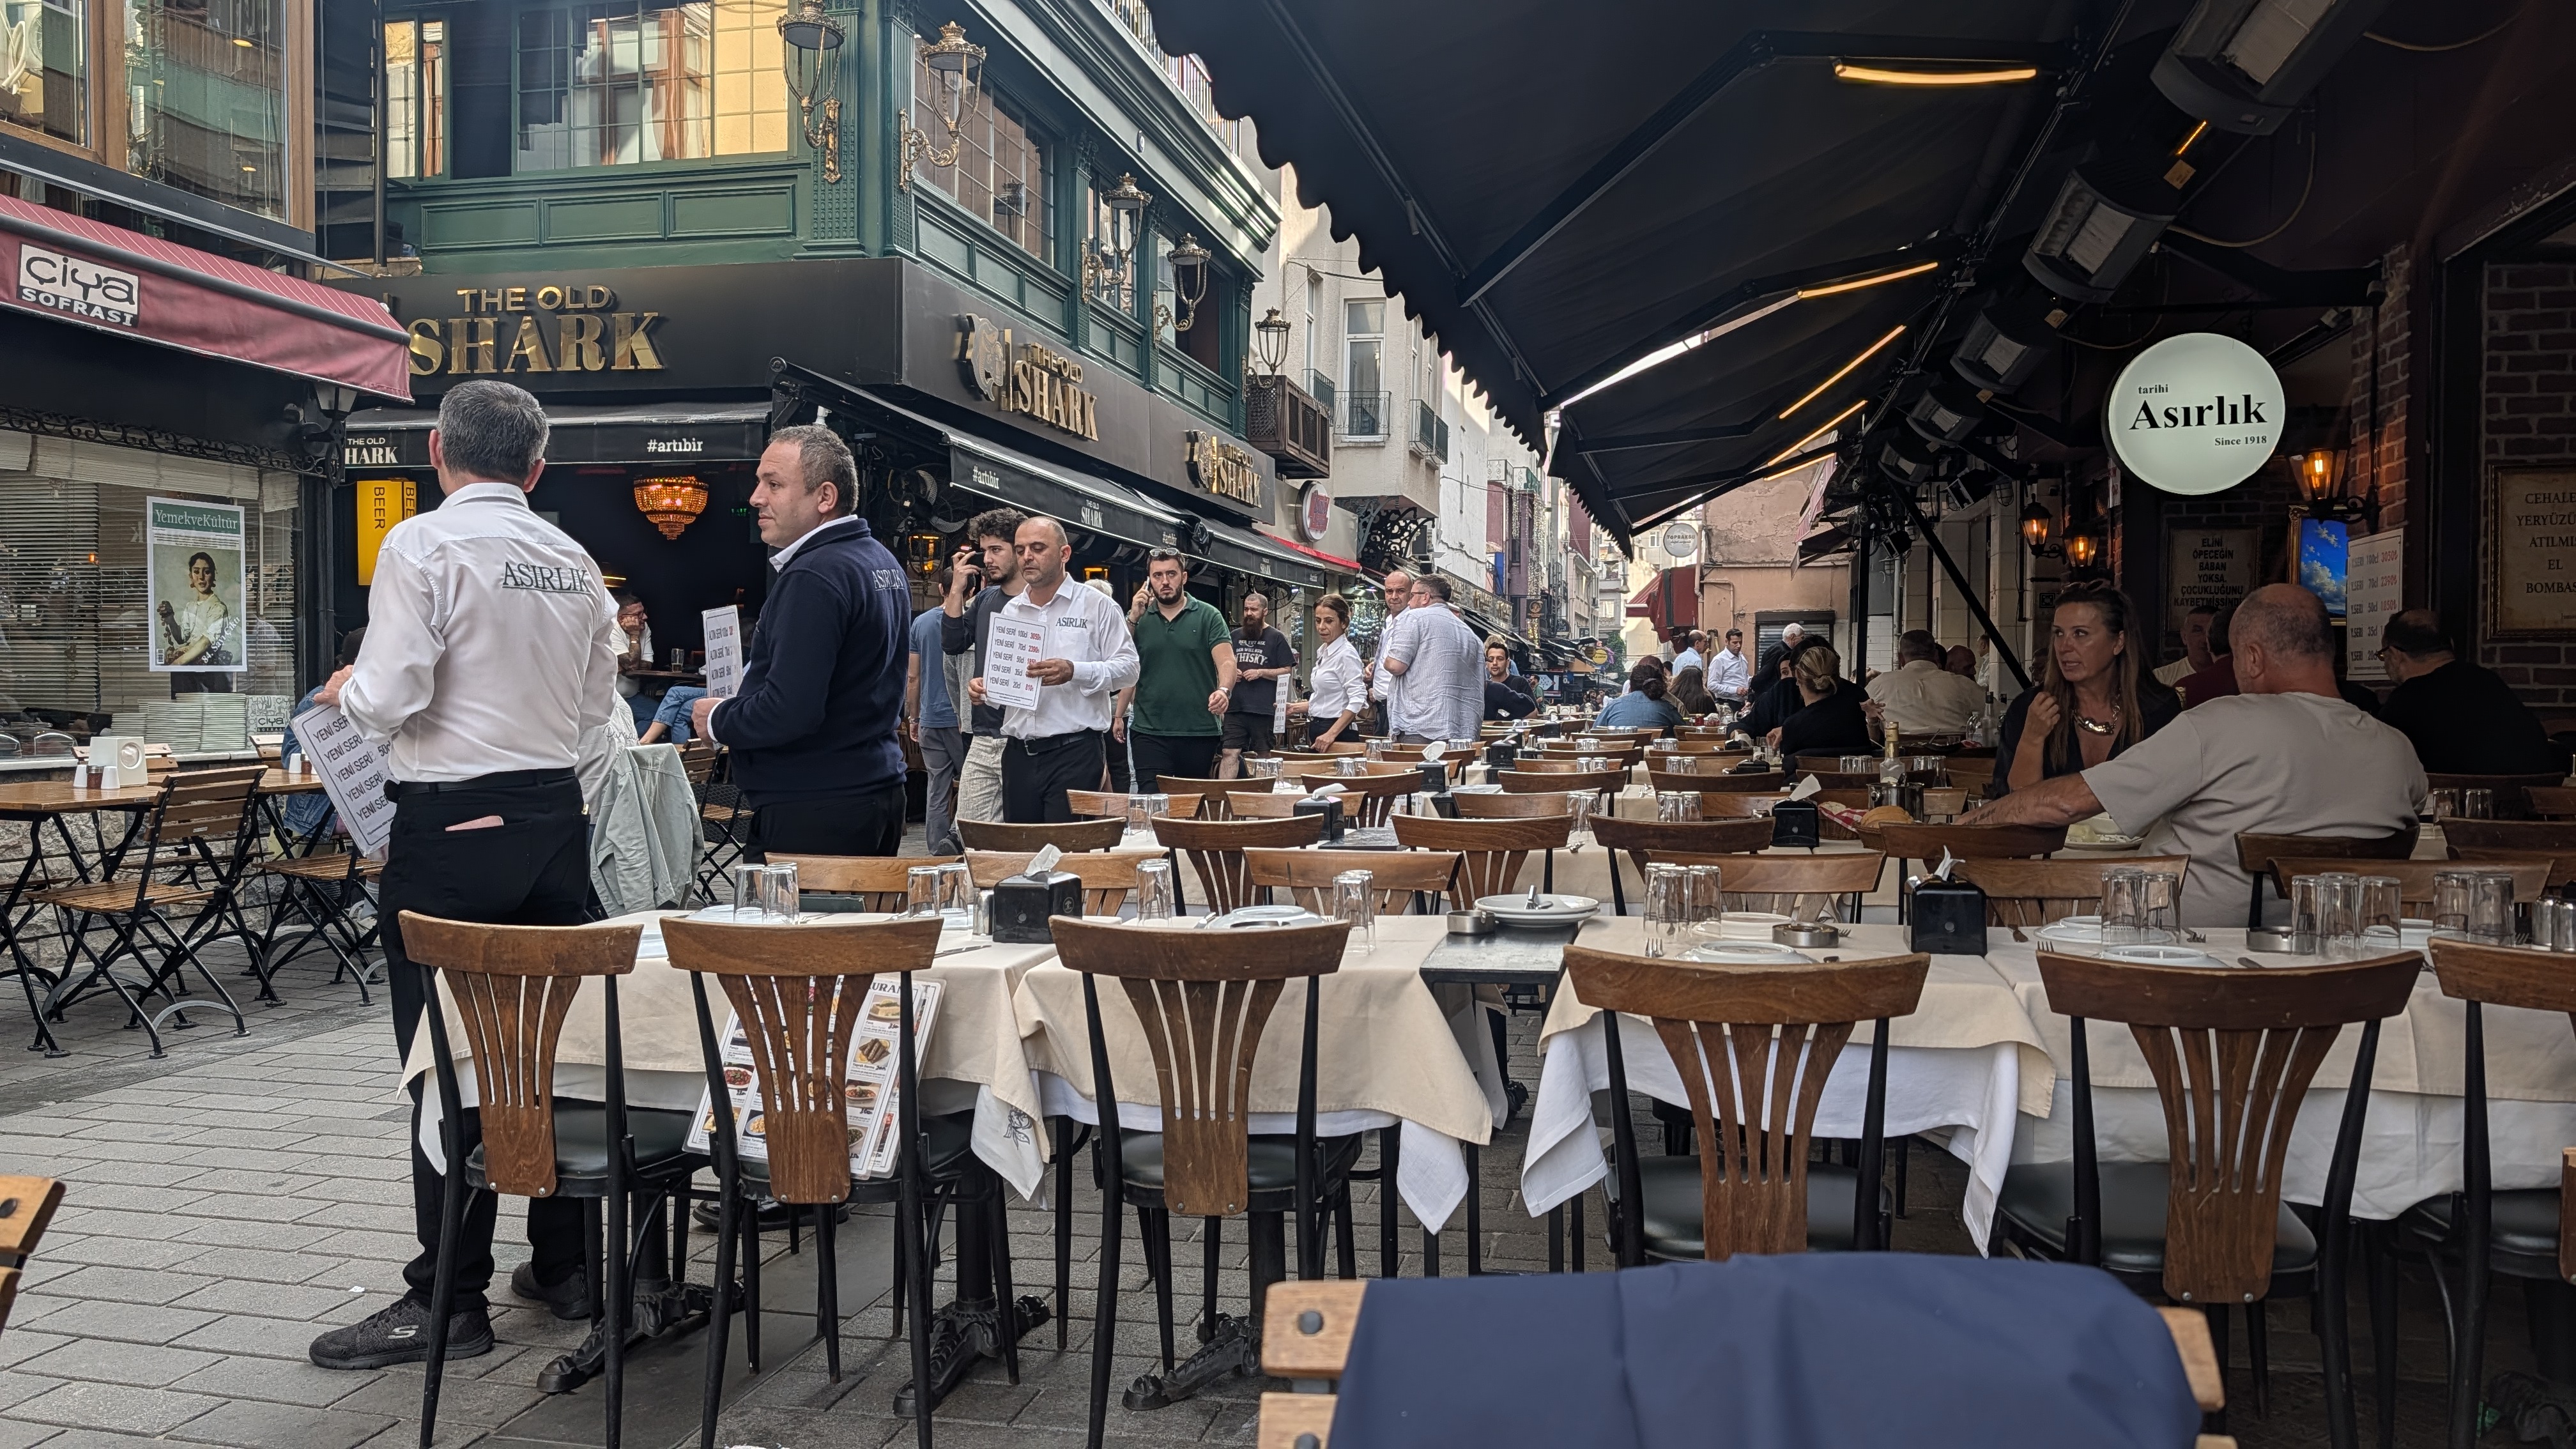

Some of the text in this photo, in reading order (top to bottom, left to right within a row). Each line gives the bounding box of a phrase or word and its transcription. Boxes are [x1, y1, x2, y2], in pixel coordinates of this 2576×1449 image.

[22, 288, 134, 326] SOFRASI
[457, 285, 611, 312] THE OLD
[408, 312, 666, 375] SHARK
[1031, 342, 1084, 384] THE OLD
[2138, 384, 2168, 394] tarihi
[1016, 360, 1099, 442] SHARK
[2128, 394, 2268, 431] Asırlık
[2214, 435, 2267, 446] Since 1918
[344, 446, 398, 464] HARK
[1229, 443, 1254, 468] THE OLD
[1218, 457, 1262, 509] SHARK
[374, 487, 386, 530] BEER
[406, 487, 415, 519] BEE
[155, 509, 238, 530] YemekveKültür
[1081, 506, 1103, 529] SHARK
[2198, 561, 2227, 571] BABAN
[2547, 559, 2563, 570] EL
[503, 562, 591, 592] ASIRLIK
[996, 625, 1006, 634] YENİ
[1006, 627, 1016, 636] SERİ
[1055, 617, 1088, 629] ASIRLIK
[994, 638, 1004, 647] YENİ
[1004, 640, 1015, 648] SERİ
[992, 663, 1001, 671] YENİ
[1001, 666, 1011, 674] SERİ
[1002, 653, 1013, 661] SERİ
[999, 678, 1009, 687] SERİ
[313, 715, 351, 743] YENİ SER
[324, 742, 345, 763] YENİ
[334, 762, 356, 783] YENİ
[353, 751, 374, 772] SERİ
[345, 770, 384, 802] YENİ SERİ
[356, 801, 377, 821] YENİ
